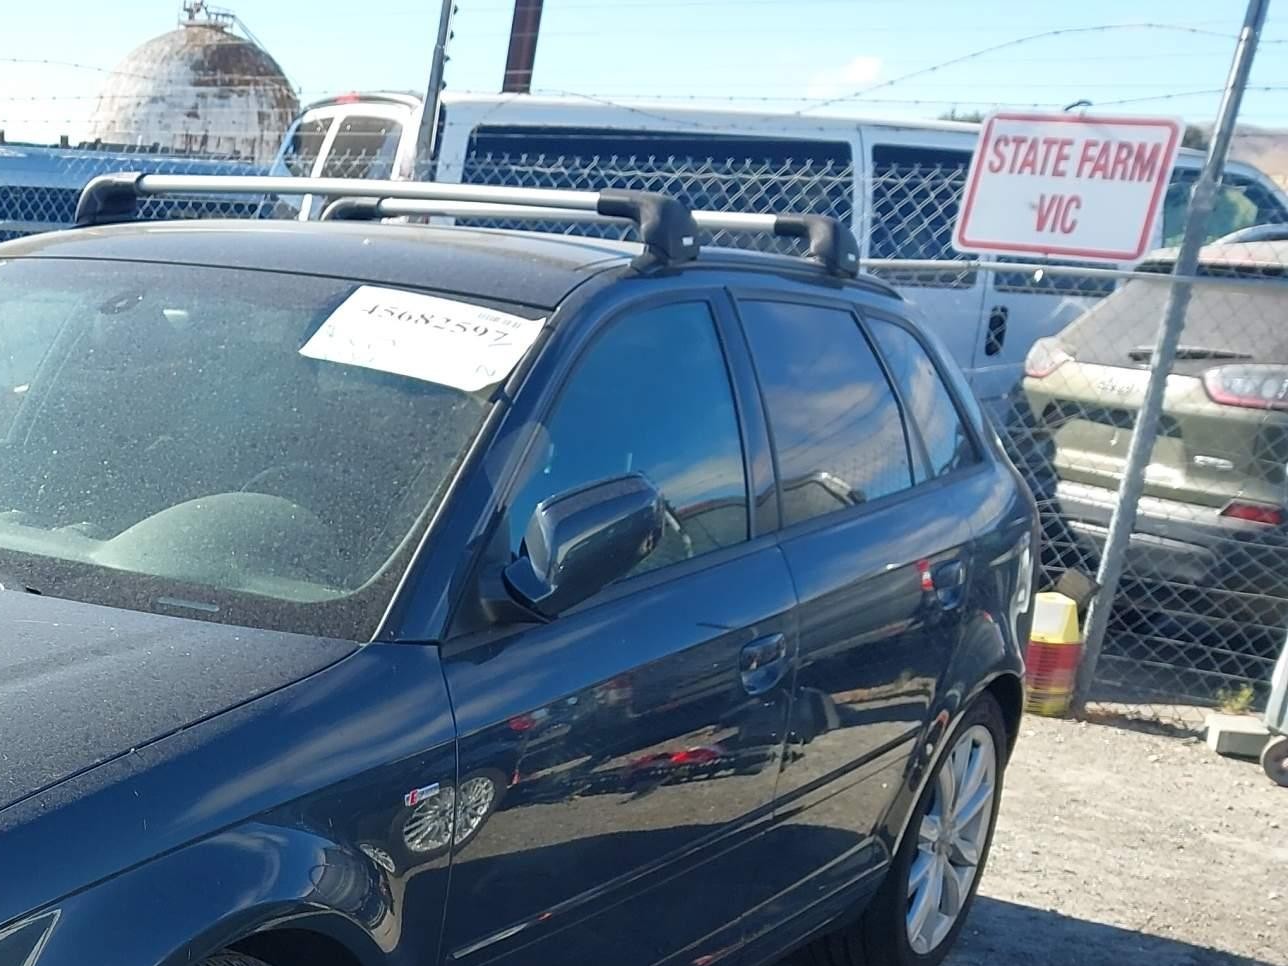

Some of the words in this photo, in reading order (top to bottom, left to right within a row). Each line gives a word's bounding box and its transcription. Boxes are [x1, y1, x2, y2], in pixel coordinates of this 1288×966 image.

[988, 134, 1075, 177] STATE
[1075, 138, 1162, 183] FARM
[1034, 193, 1082, 235] VIC
